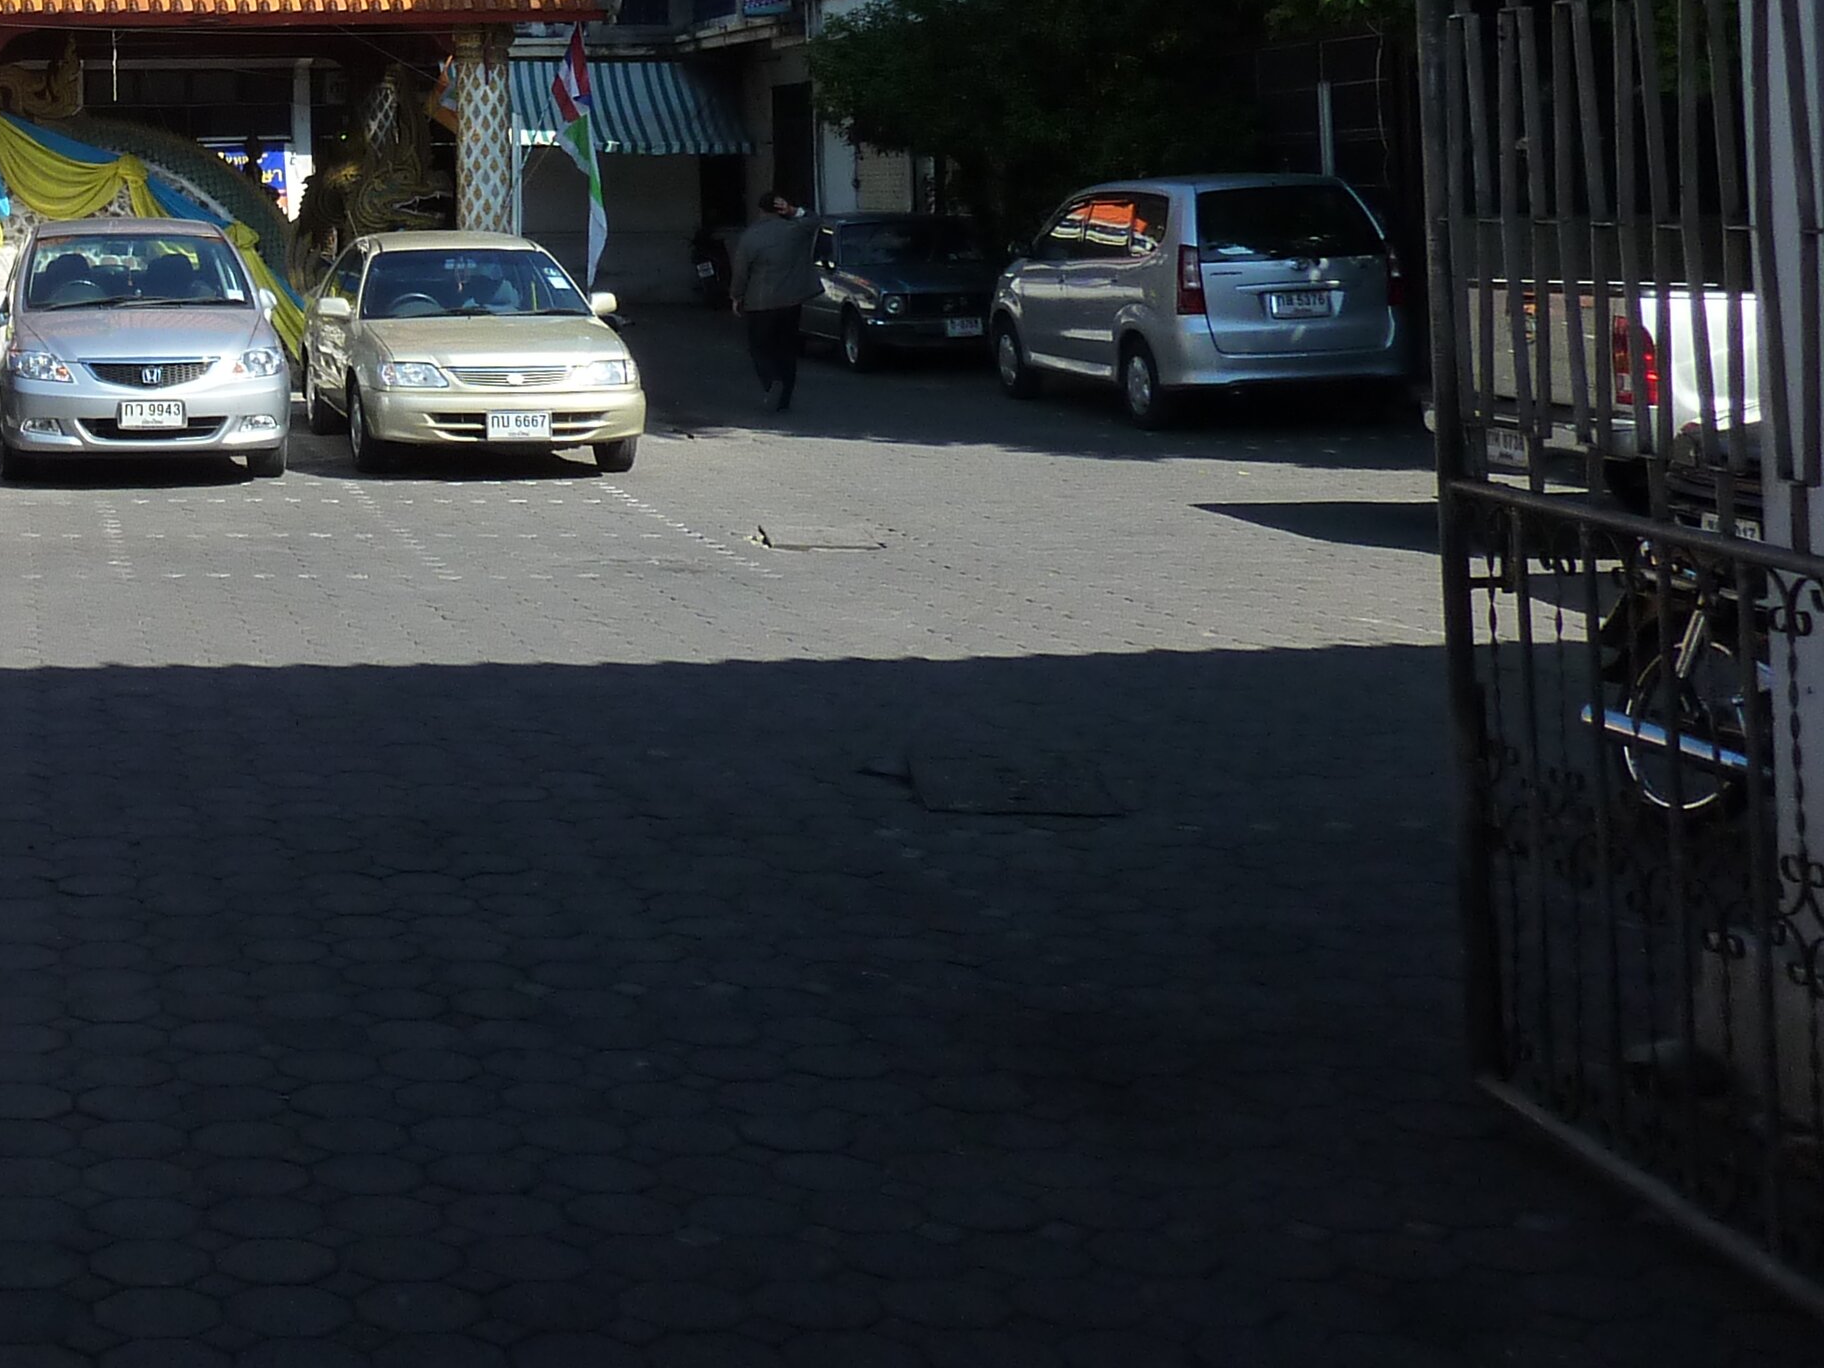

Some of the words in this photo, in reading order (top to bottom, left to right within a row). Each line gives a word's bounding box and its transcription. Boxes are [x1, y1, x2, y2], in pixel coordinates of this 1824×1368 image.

[148, 403, 181, 417] 9943
[491, 415, 510, 428] กบ
[515, 415, 547, 428] 6667
